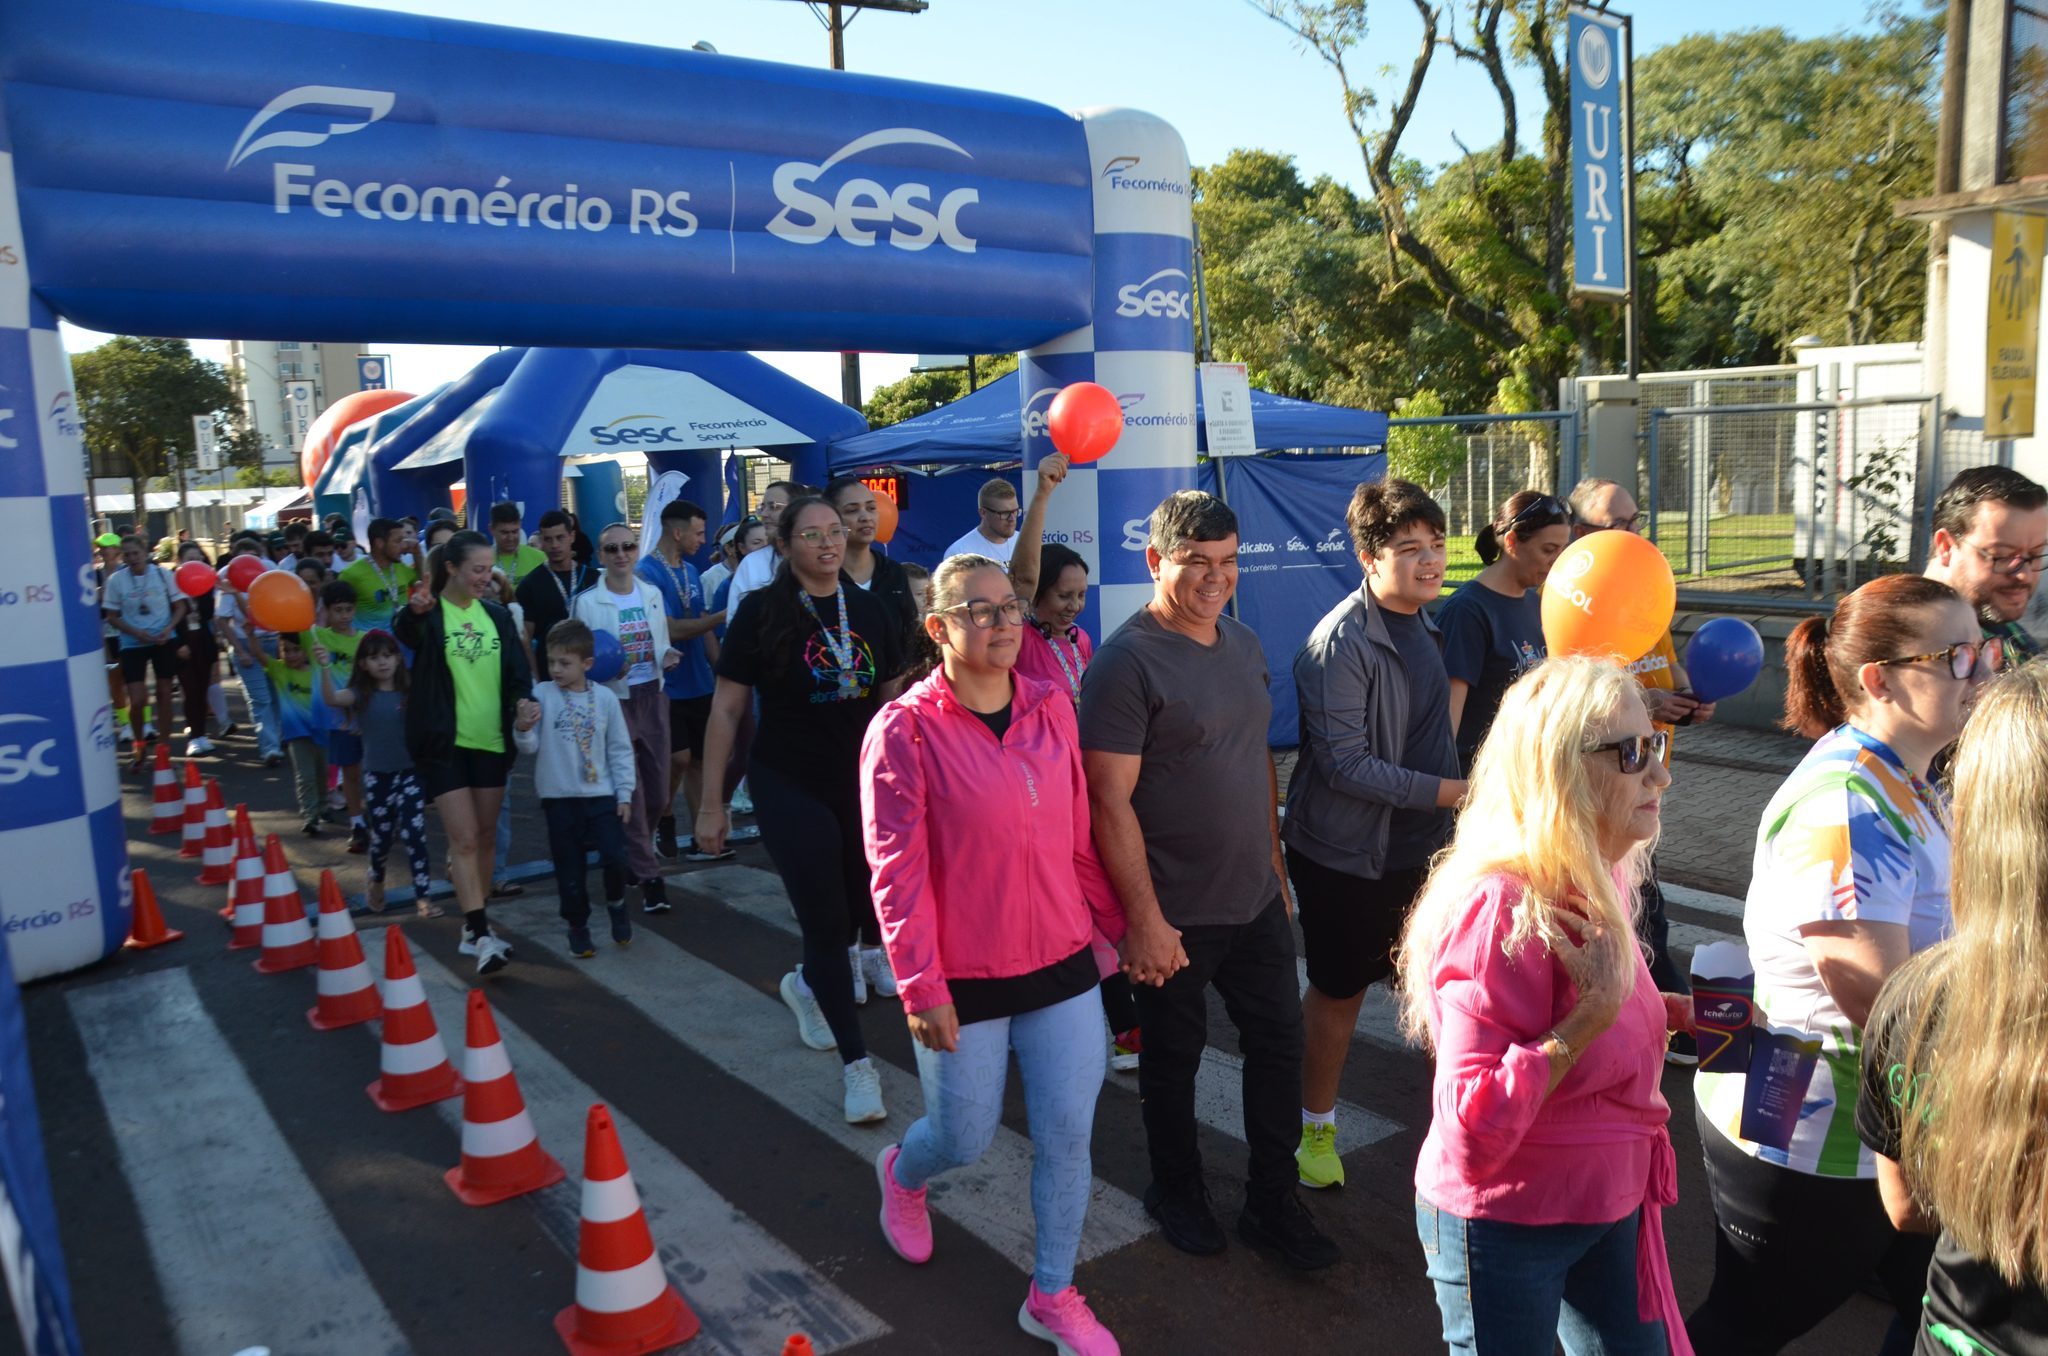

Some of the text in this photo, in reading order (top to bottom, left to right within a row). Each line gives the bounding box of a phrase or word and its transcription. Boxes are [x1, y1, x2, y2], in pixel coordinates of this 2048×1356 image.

[1112, 176, 1183, 195] Fecomércio
[1582, 101, 1612, 281] URI
[273, 162, 698, 238] Fecomércio RS
[689, 418, 768, 431] Fecomércio
[1122, 412, 1188, 426] ecomércio
[1073, 530, 1094, 543] RS
[25, 584, 55, 604] RS
[69, 898, 95, 919] RS
